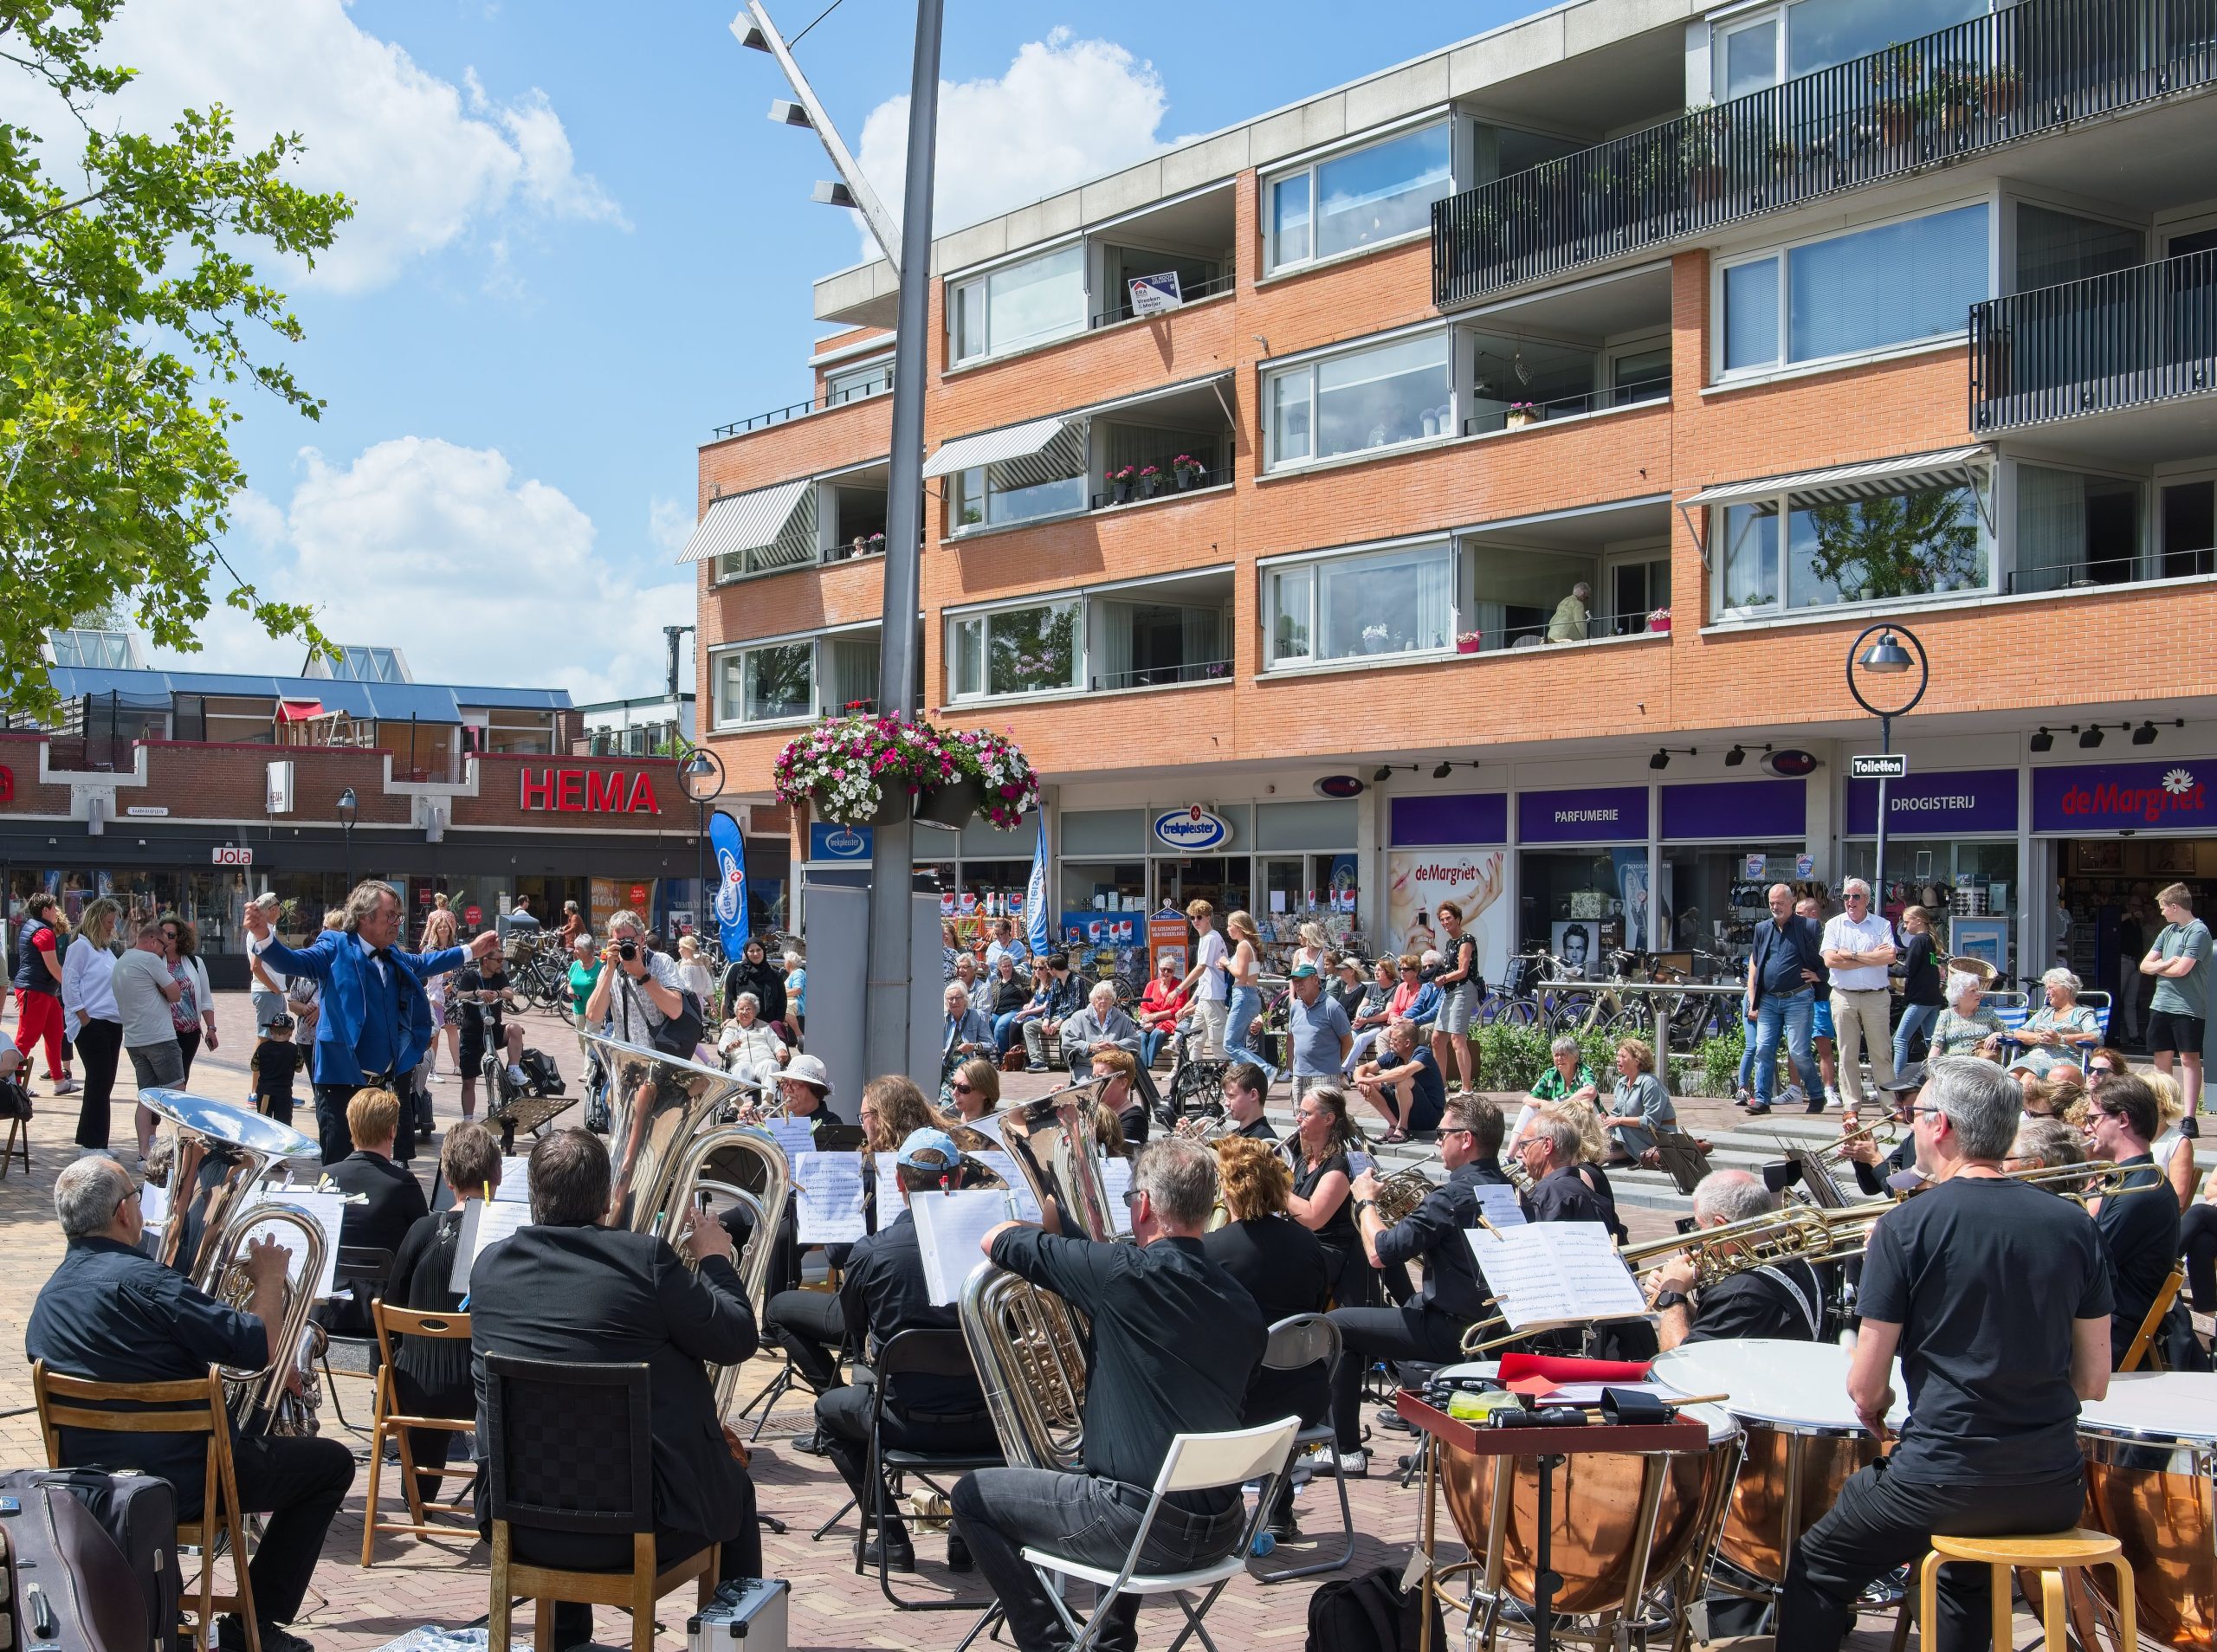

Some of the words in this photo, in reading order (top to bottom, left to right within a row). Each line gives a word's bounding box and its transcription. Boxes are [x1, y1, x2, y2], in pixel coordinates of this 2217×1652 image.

[1854, 759, 1901, 773] Toiletten
[520, 767, 660, 814] HEMA
[1891, 795, 1975, 811] DROGISTERIJ
[1554, 809, 1619, 823] PARFUMERIE
[1163, 822, 1214, 837] trekpleister
[830, 837, 859, 848] trekpleister
[214, 849, 251, 865] Jola
